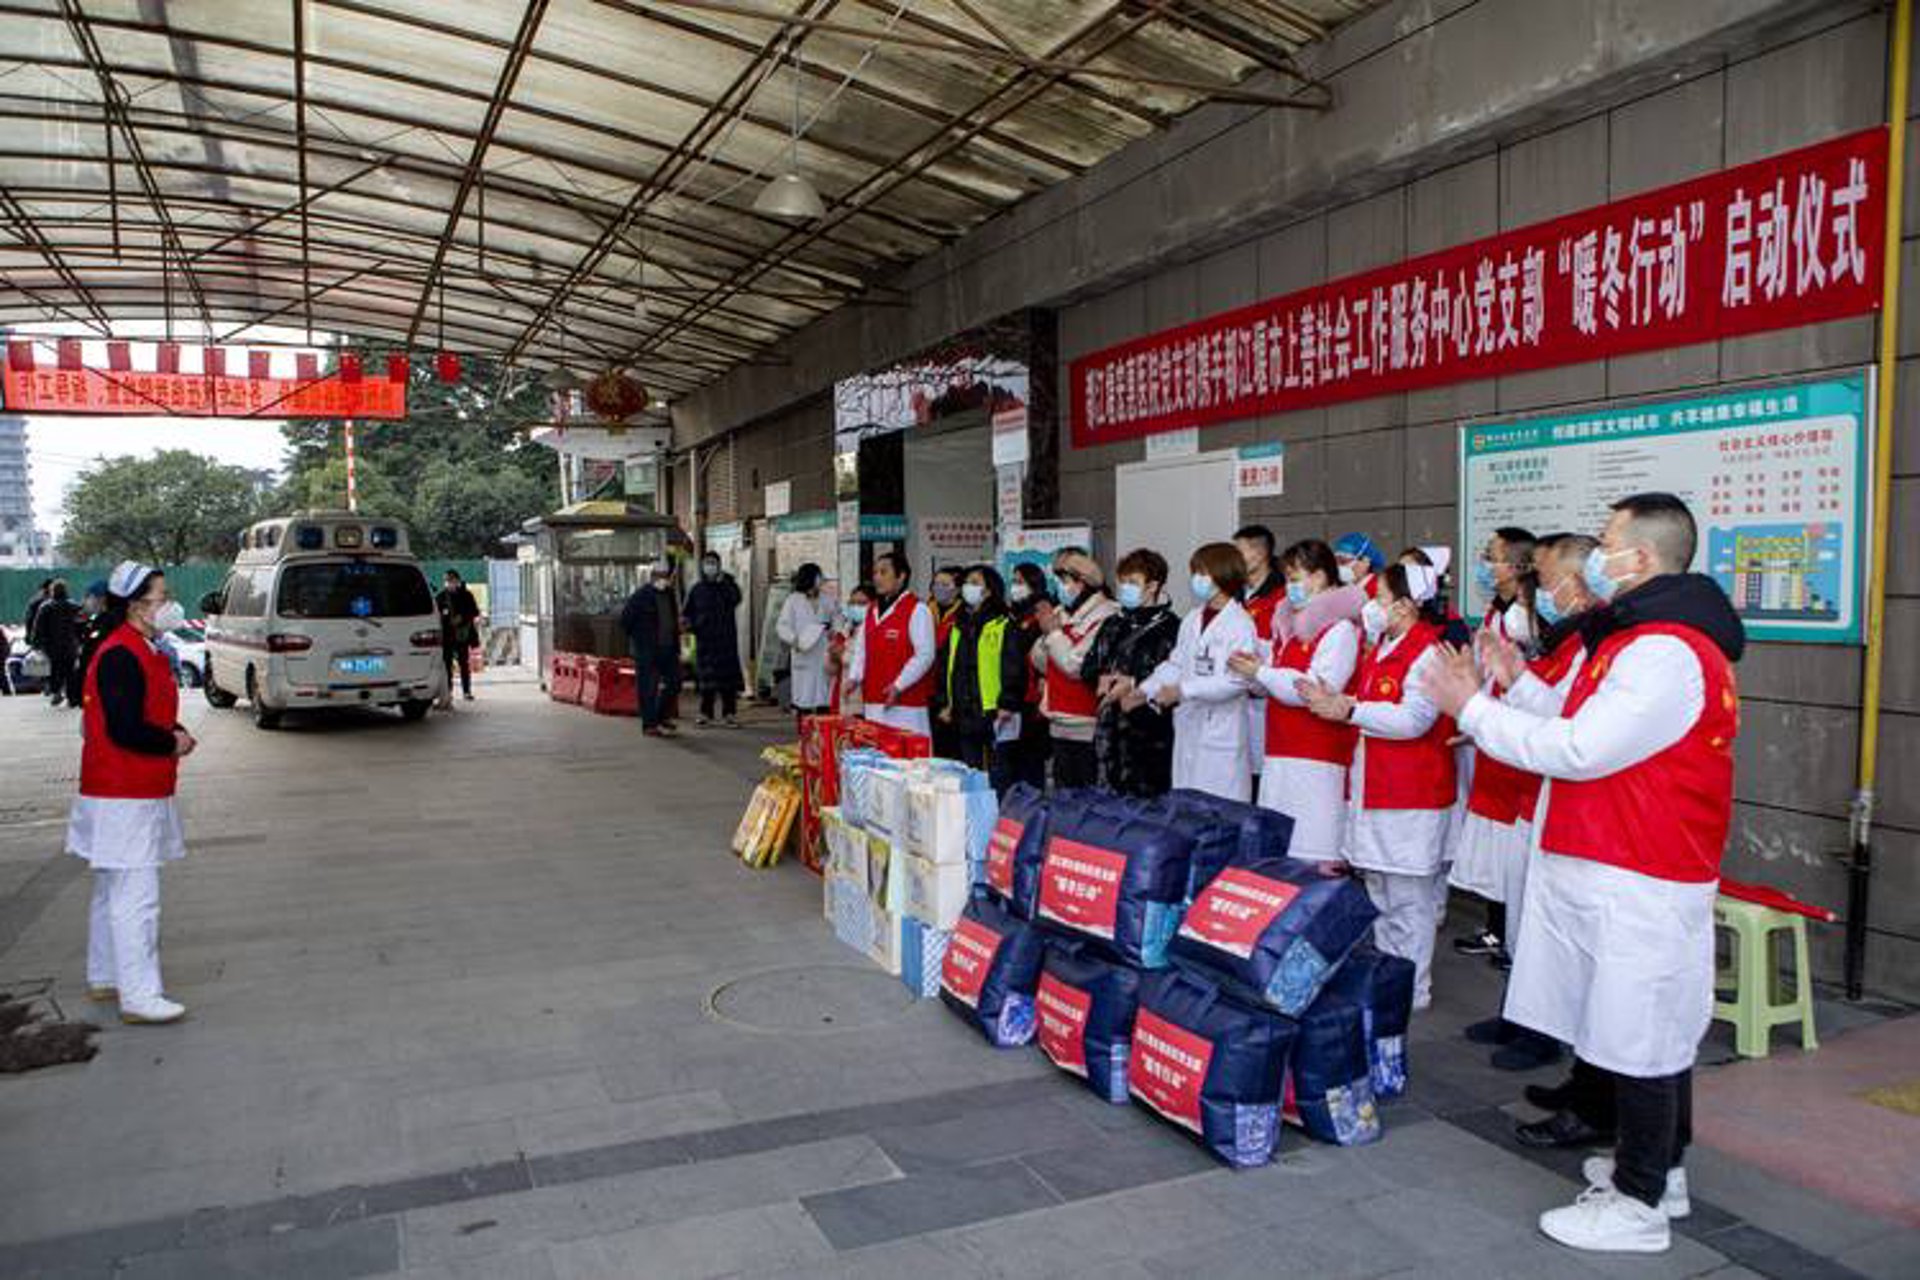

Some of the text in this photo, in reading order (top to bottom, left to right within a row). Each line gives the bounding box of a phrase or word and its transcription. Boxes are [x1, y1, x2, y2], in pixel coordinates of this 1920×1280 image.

[1558, 201, 1705, 336] “暖冬行动”
[1722, 157, 1869, 308] 启动仪式
